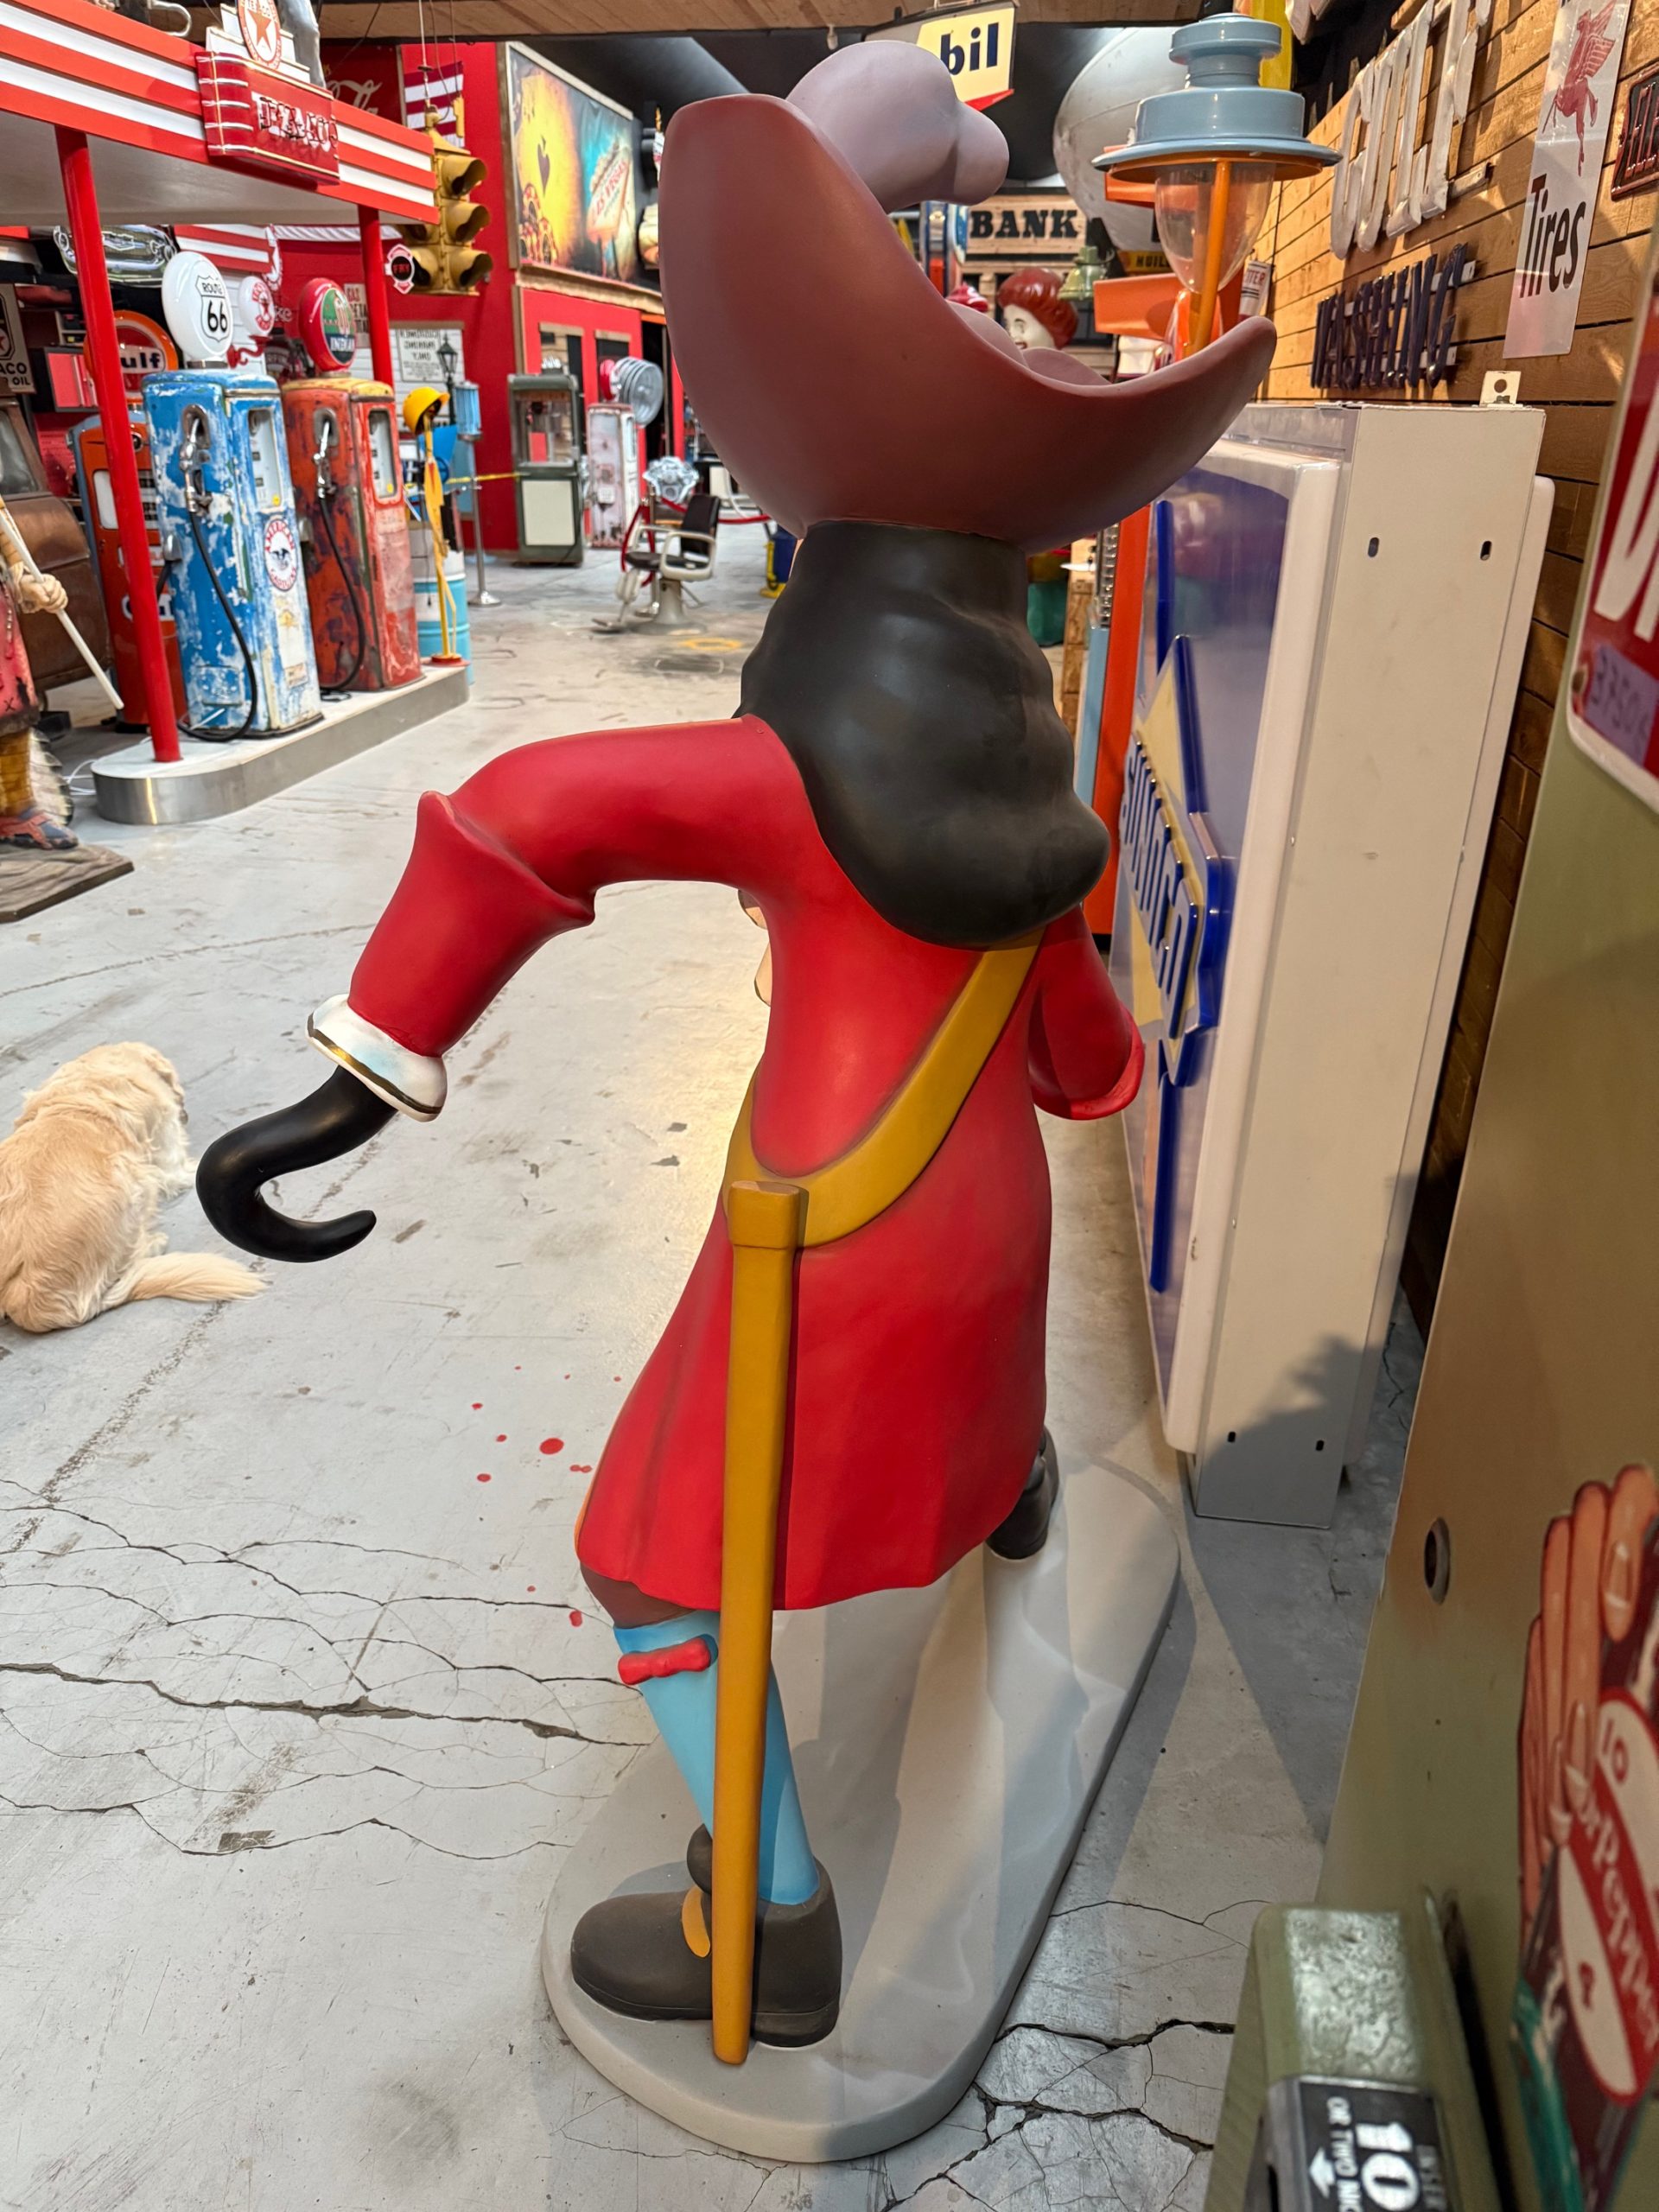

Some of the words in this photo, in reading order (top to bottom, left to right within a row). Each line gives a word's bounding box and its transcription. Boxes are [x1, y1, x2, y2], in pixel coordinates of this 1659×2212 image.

[251, 92, 338, 152] TEXACO
[970, 210, 1078, 239] BANK
[1520, 173, 1586, 297] Tires
[201, 282, 223, 296] ROUTE
[207, 300, 228, 333] 66
[119, 353, 161, 369] ulf
[12, 376, 31, 385] OIL
[1120, 731, 1198, 1040] SUNOCO
[1326, 2096, 1352, 2126] OR
[1330, 2128, 1358, 2177] TWO
[1356, 2120, 1421, 2211] 10
